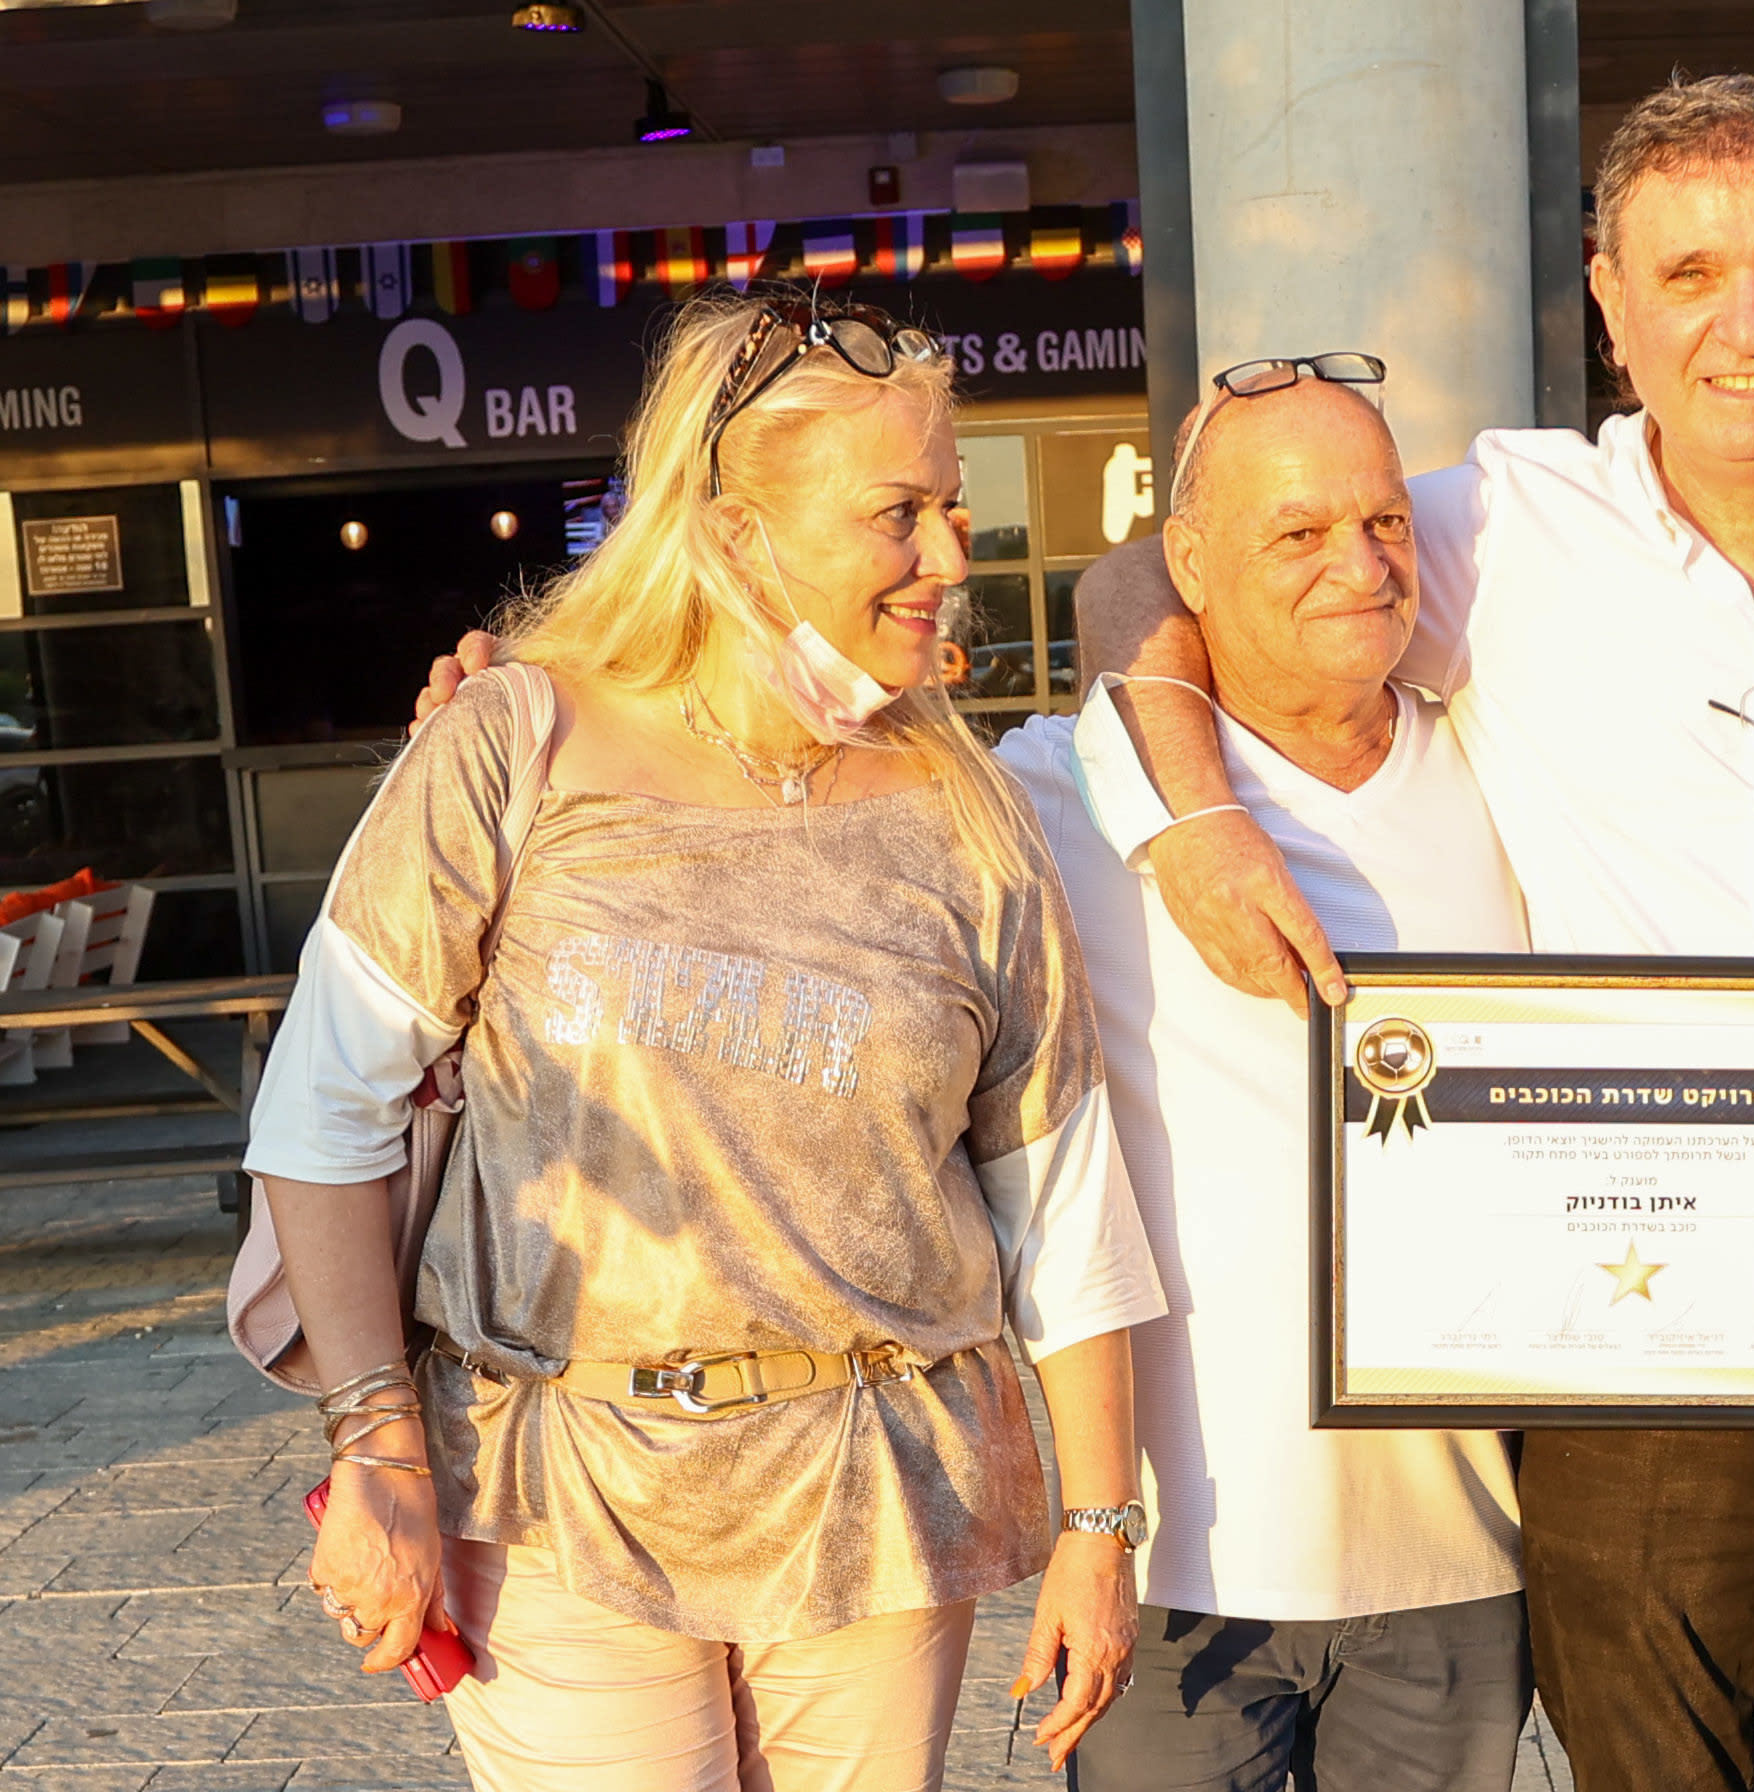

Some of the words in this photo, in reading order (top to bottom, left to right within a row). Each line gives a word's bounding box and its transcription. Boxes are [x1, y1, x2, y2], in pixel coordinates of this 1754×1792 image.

[993, 332, 1028, 373] &
[378, 318, 468, 448] Q
[486, 385, 577, 438] BAR
[1489, 1087, 1592, 1104] הכוכבים
[1601, 1087, 1673, 1105] שדרת
[1547, 1135, 1577, 1145] יוצאי
[1581, 1134, 1629, 1147] להישגיך
[1633, 1136, 1682, 1146] העמוקה
[1685, 1136, 1739, 1146] הערכתנו
[1511, 1150, 1545, 1161] תקוה
[1548, 1150, 1577, 1160] פתח
[1584, 1150, 1609, 1161] בעיר
[1612, 1149, 1659, 1161] לספורט
[1663, 1151, 1712, 1162] תרומתך
[1715, 1150, 1747, 1161] ובשל
[1620, 1176, 1658, 1186] מוענק
[1566, 1195, 1642, 1212] בודניוק
[1650, 1196, 1697, 1213] איתן
[1567, 1222, 1617, 1233] הכוכבים
[1621, 1222, 1666, 1233] בשדרת
[1669, 1222, 1697, 1233] כוכב
